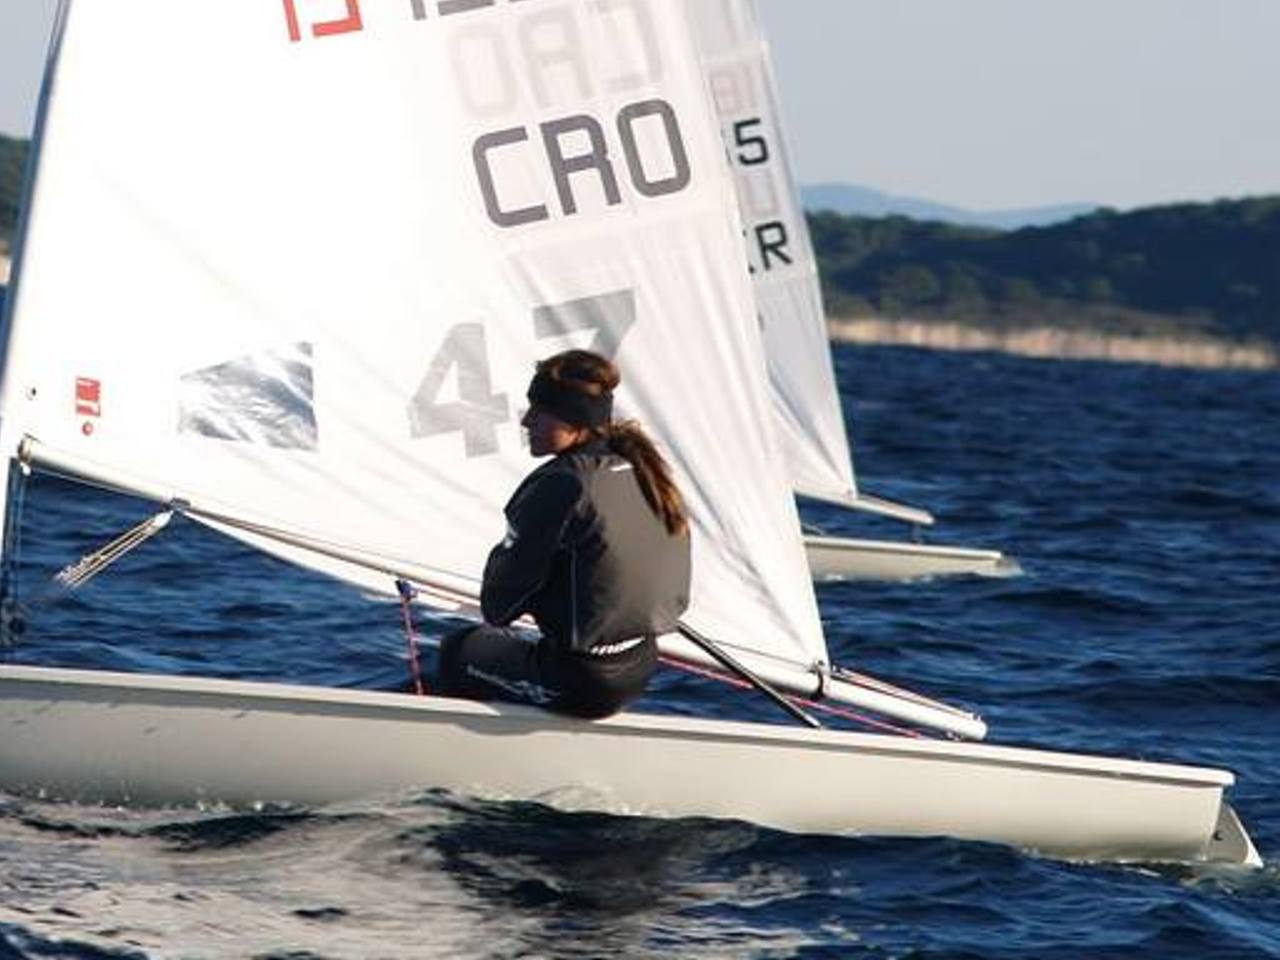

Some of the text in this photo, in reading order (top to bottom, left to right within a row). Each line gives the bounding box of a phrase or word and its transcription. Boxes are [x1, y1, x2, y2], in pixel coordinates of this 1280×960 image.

[472, 98, 691, 228] CRO
[723, 117, 770, 167] 5
[742, 220, 793, 275] R
